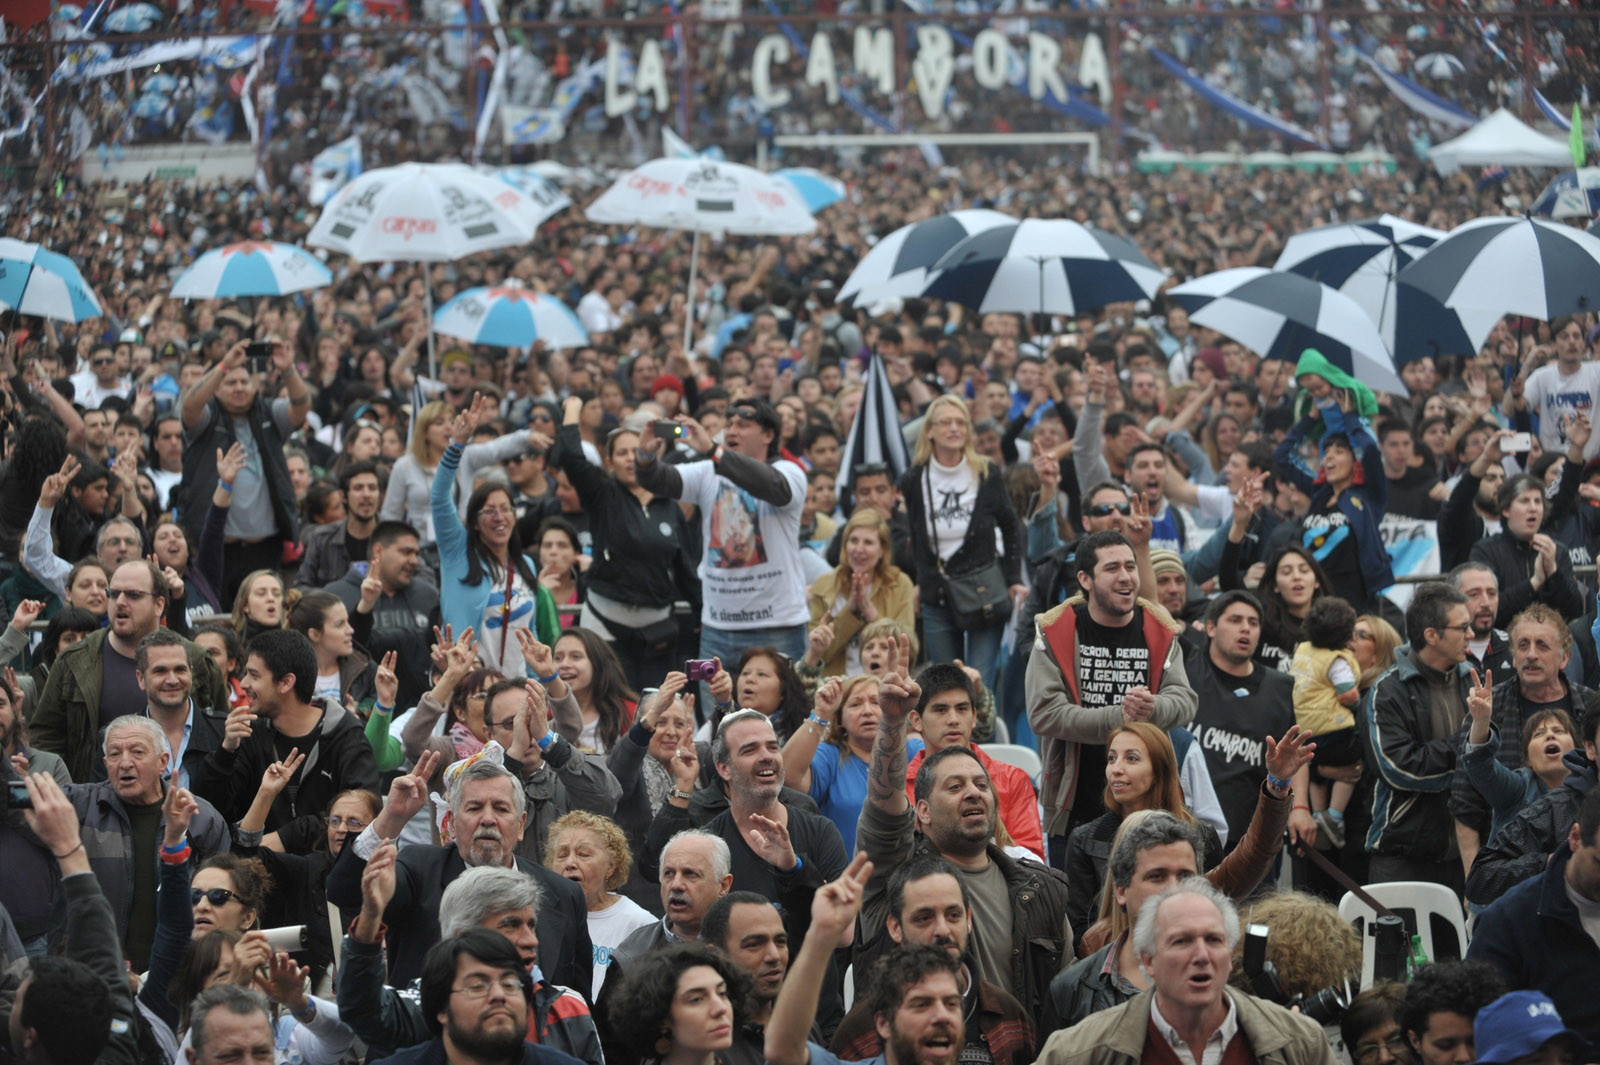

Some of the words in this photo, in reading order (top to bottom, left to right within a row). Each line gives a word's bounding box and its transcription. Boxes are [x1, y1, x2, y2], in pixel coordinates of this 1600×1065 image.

[604, 37, 669, 118] LA
[1094, 660, 1131, 670] GRANDE
[1134, 661, 1147, 670] SO
[1094, 669, 1145, 683] GENERA
